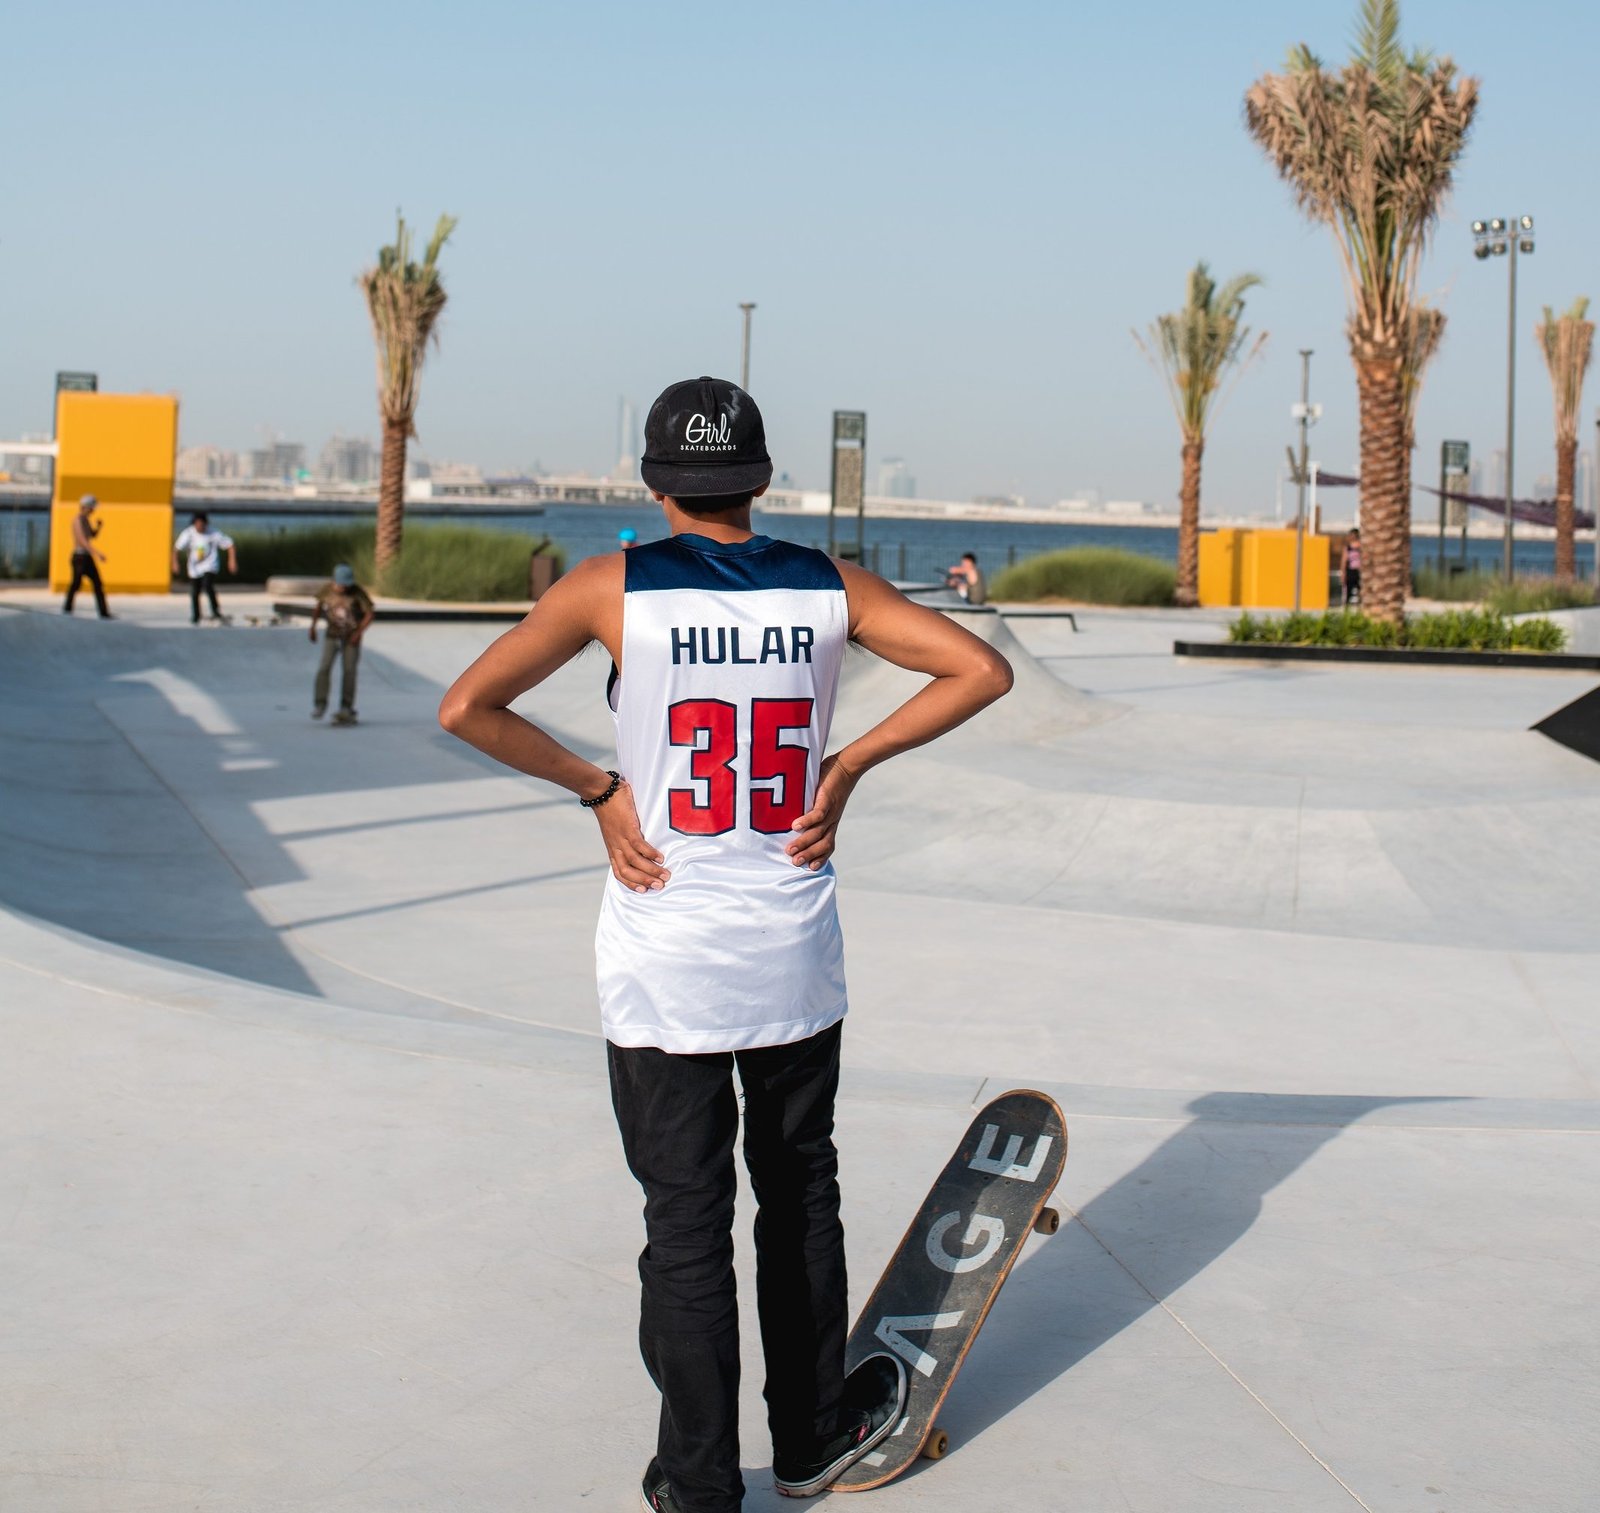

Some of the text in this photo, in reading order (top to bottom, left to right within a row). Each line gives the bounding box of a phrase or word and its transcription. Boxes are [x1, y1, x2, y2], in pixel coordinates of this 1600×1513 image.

[686, 413, 731, 443] Girl
[680, 444, 737, 452] SKATEBOARDS
[671, 626, 814, 665] HULAR
[668, 698, 814, 836] 35
[862, 1123, 1053, 1467] AGE
